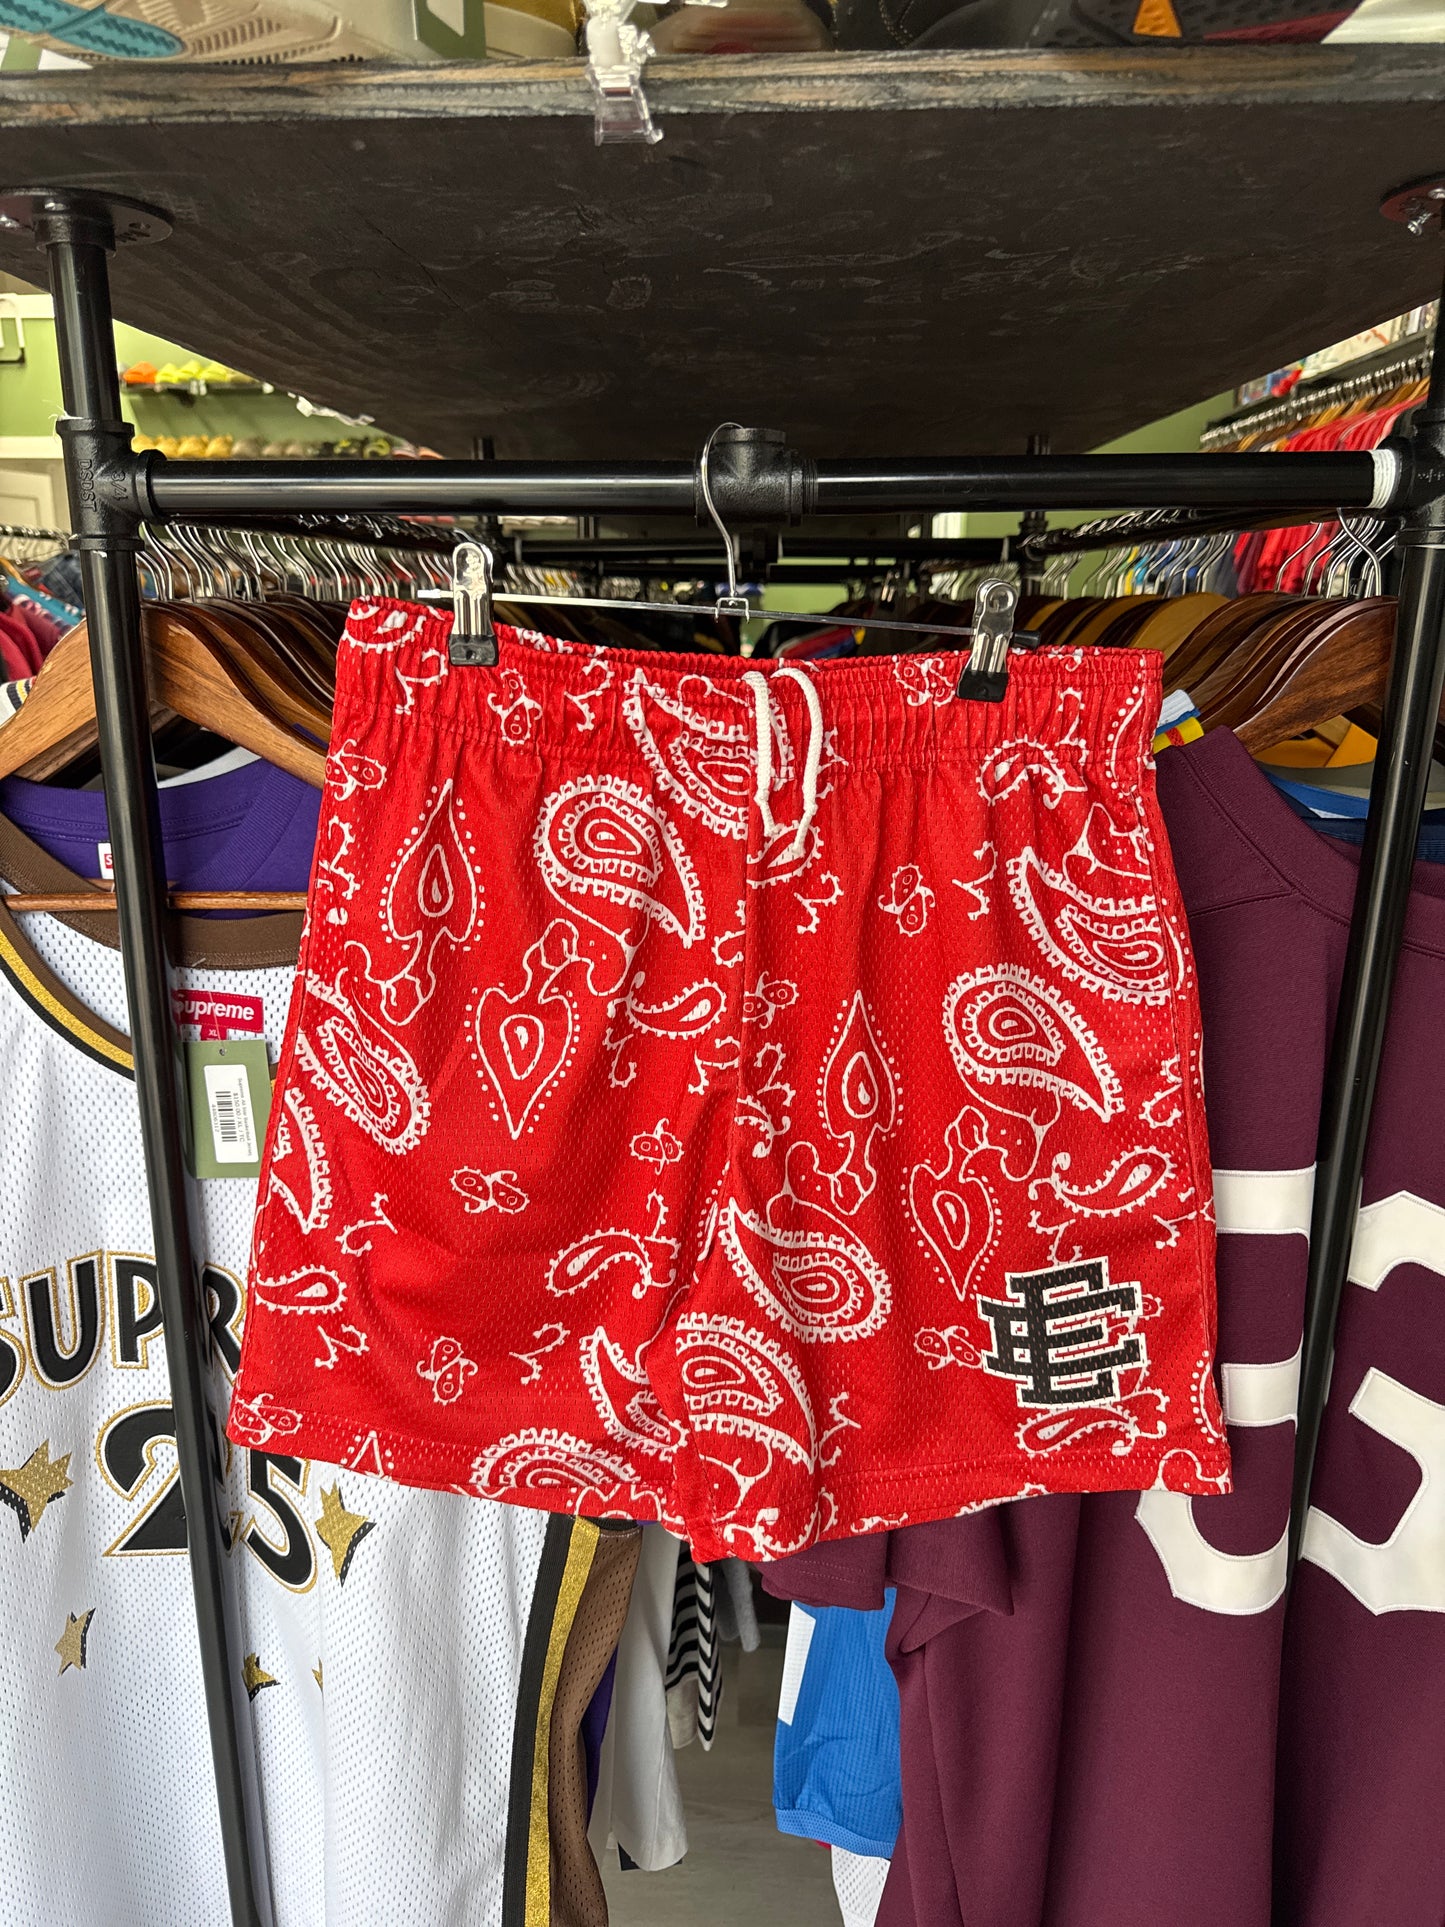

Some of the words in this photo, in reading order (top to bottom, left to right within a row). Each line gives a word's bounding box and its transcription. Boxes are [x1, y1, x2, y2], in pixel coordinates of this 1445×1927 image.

[111, 470, 128, 501] 3/4
[172, 993, 255, 1021] Supreme
[208, 1028, 218, 1037] XL
[237, 1120, 243, 1128] XL
[239, 1134, 245, 1143] TC
